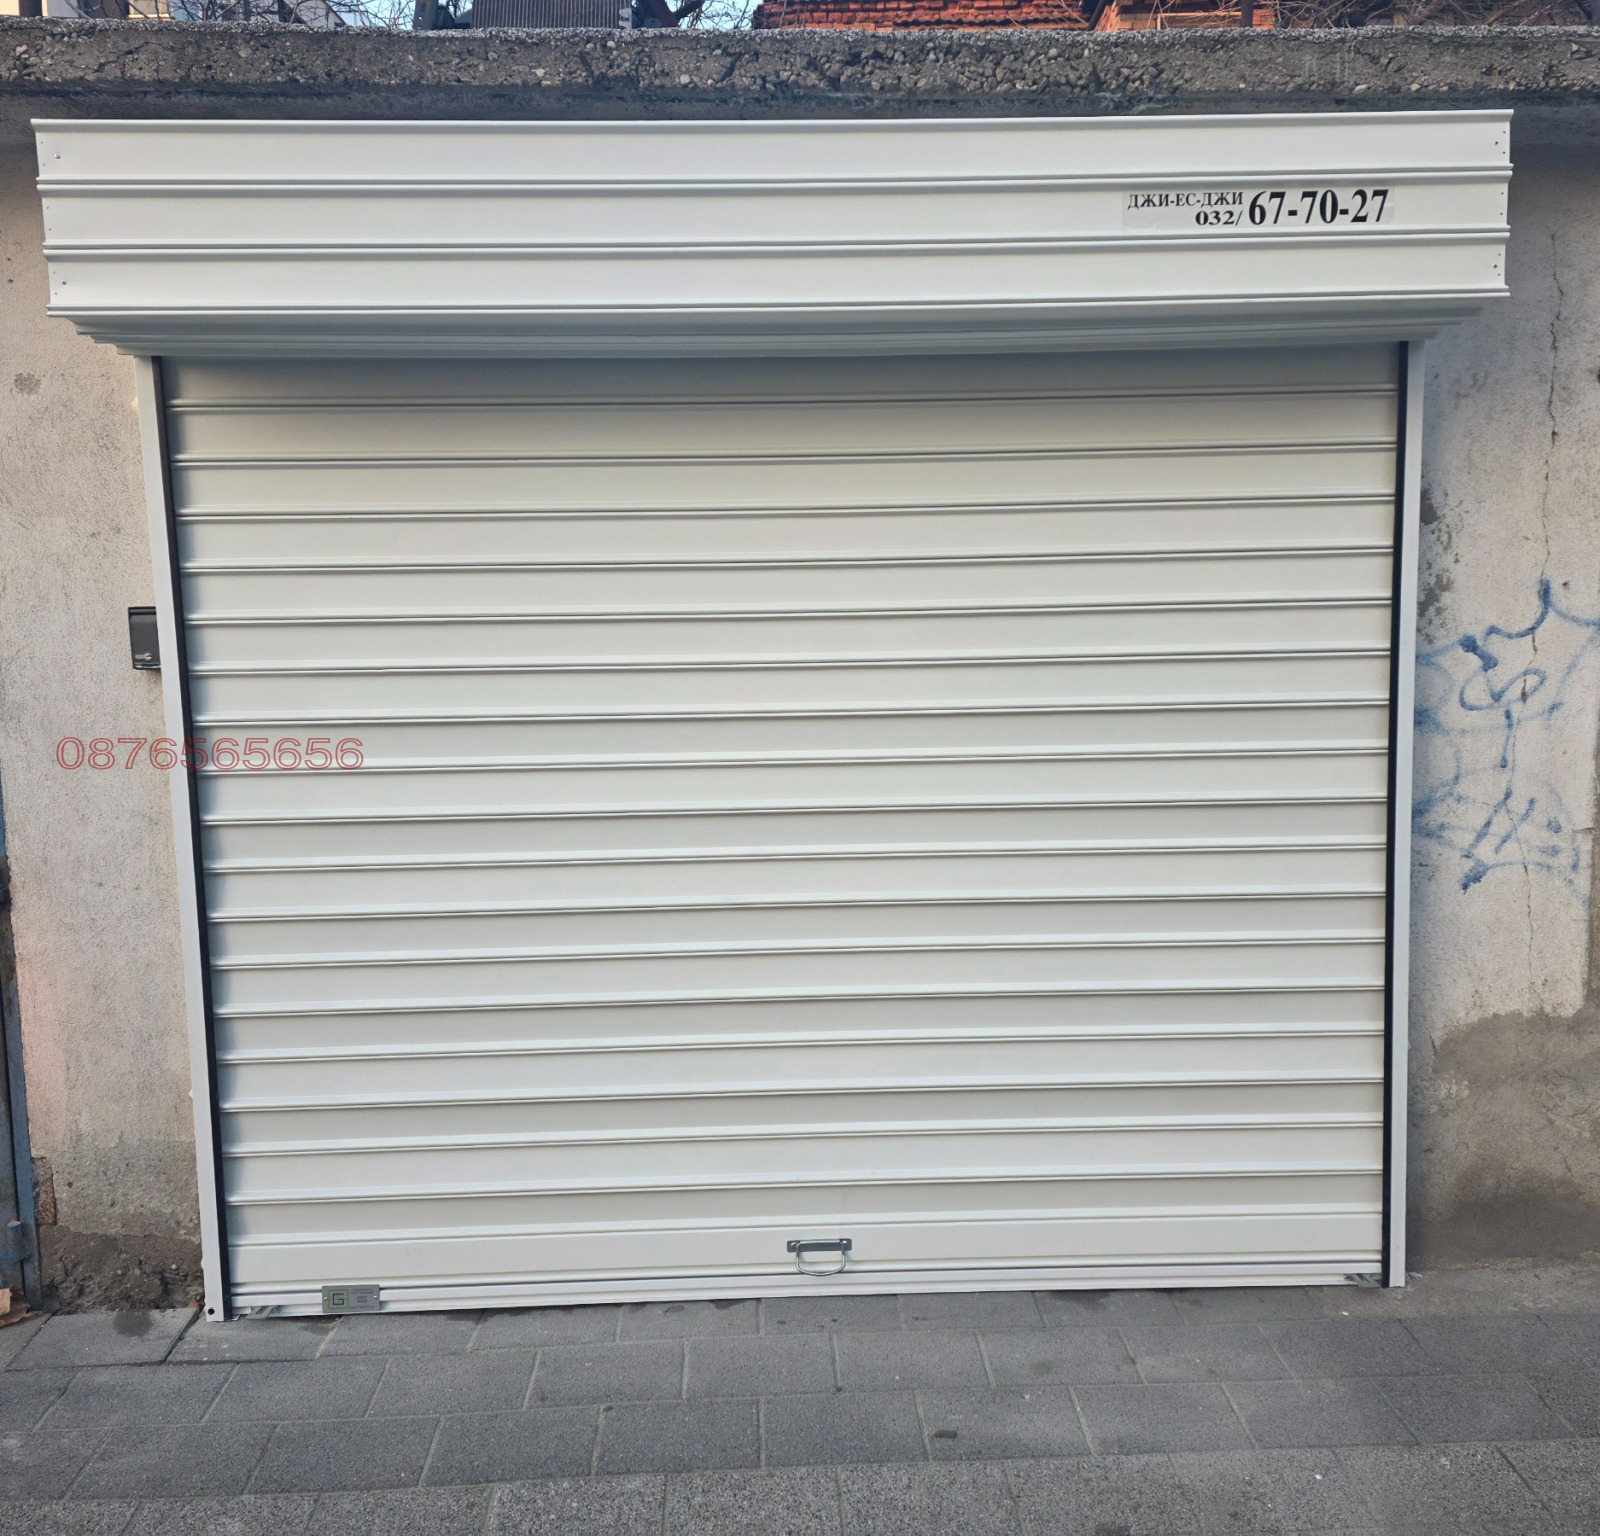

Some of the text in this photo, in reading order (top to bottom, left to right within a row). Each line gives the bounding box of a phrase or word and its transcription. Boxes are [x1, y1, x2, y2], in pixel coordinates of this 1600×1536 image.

[1128, 192, 1244, 210] ДЖИ-ЕС-ДЖИ
[1195, 189, 1389, 226] 032/ 67-70-27
